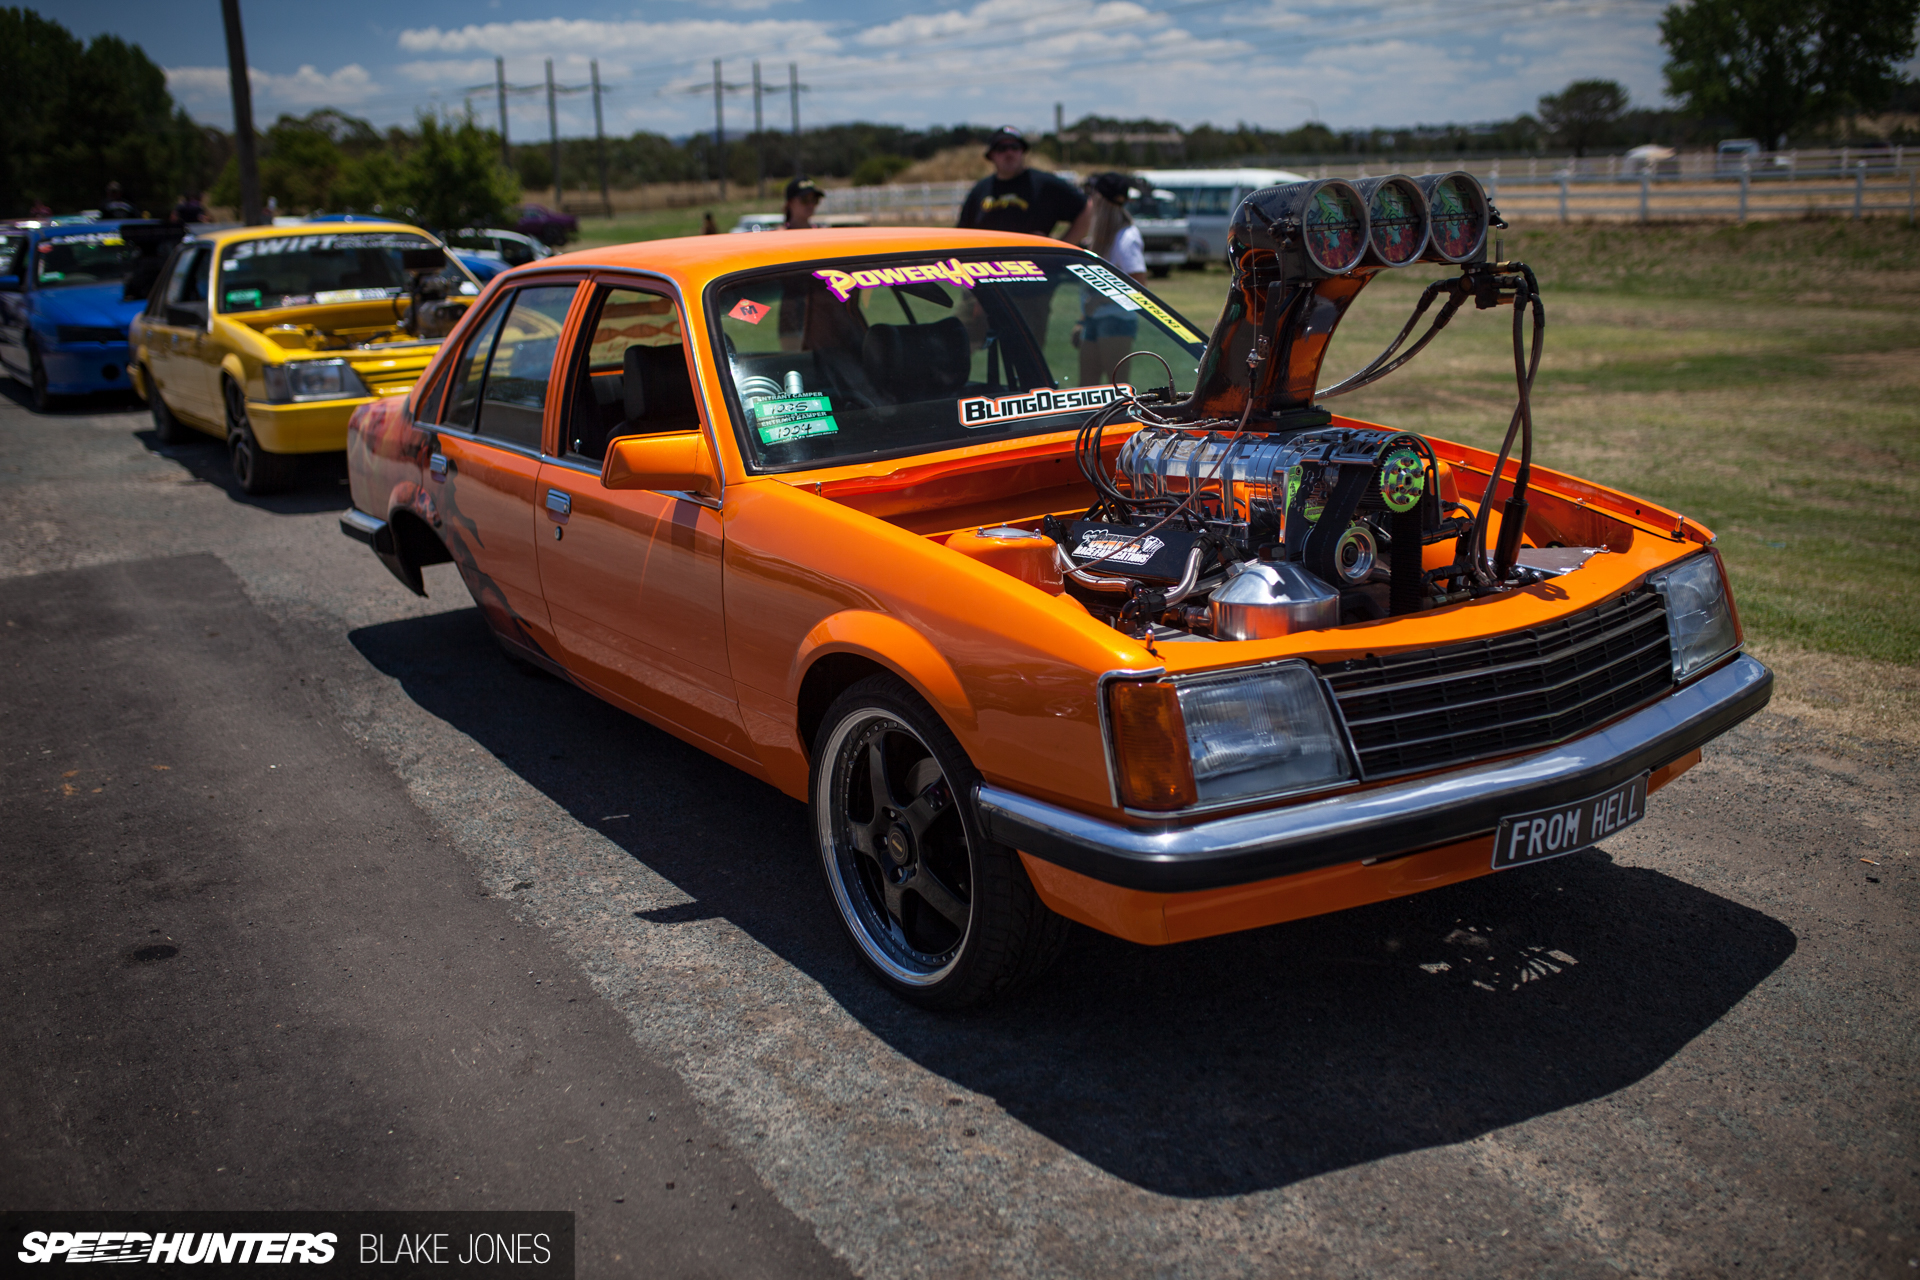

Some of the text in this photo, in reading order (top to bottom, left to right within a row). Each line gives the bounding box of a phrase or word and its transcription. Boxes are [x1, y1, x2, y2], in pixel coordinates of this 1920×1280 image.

[233, 234, 339, 260] SWIFT
[812, 258, 1046, 303] POWERHOUSE
[978, 276, 1048, 284] ENGINES
[1073, 267, 1112, 294] 1004
[740, 304, 758, 316] M
[1096, 267, 1181, 329] ENTRANT 1005
[778, 423, 812, 439] 1004
[1508, 784, 1638, 860] FROM HELL
